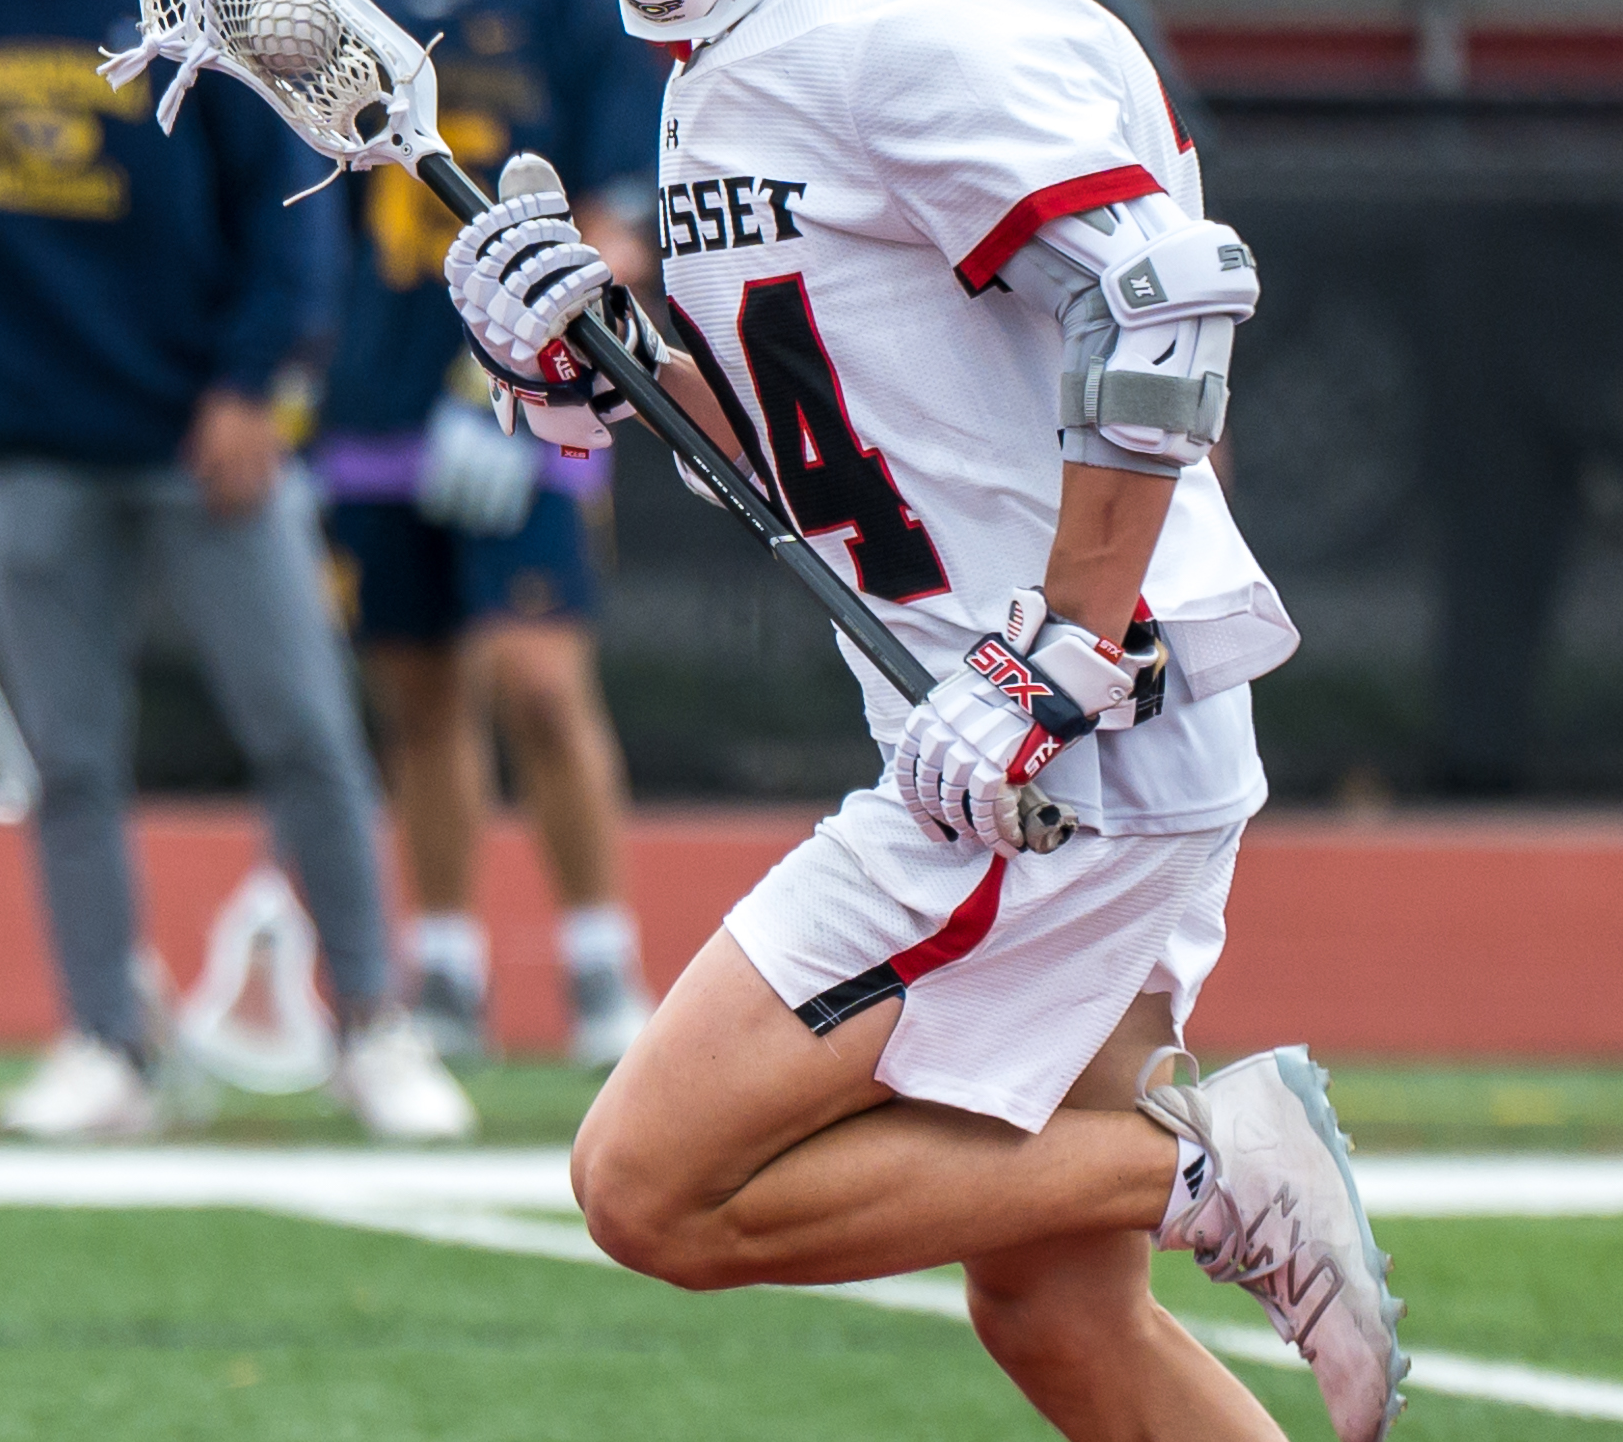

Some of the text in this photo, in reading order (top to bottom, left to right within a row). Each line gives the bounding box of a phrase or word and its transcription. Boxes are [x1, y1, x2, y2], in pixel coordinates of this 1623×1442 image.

[552, 350, 577, 381] STX
[1099, 639, 1121, 658] STX
[965, 638, 1054, 715] STX
[1023, 735, 1060, 777] STX
